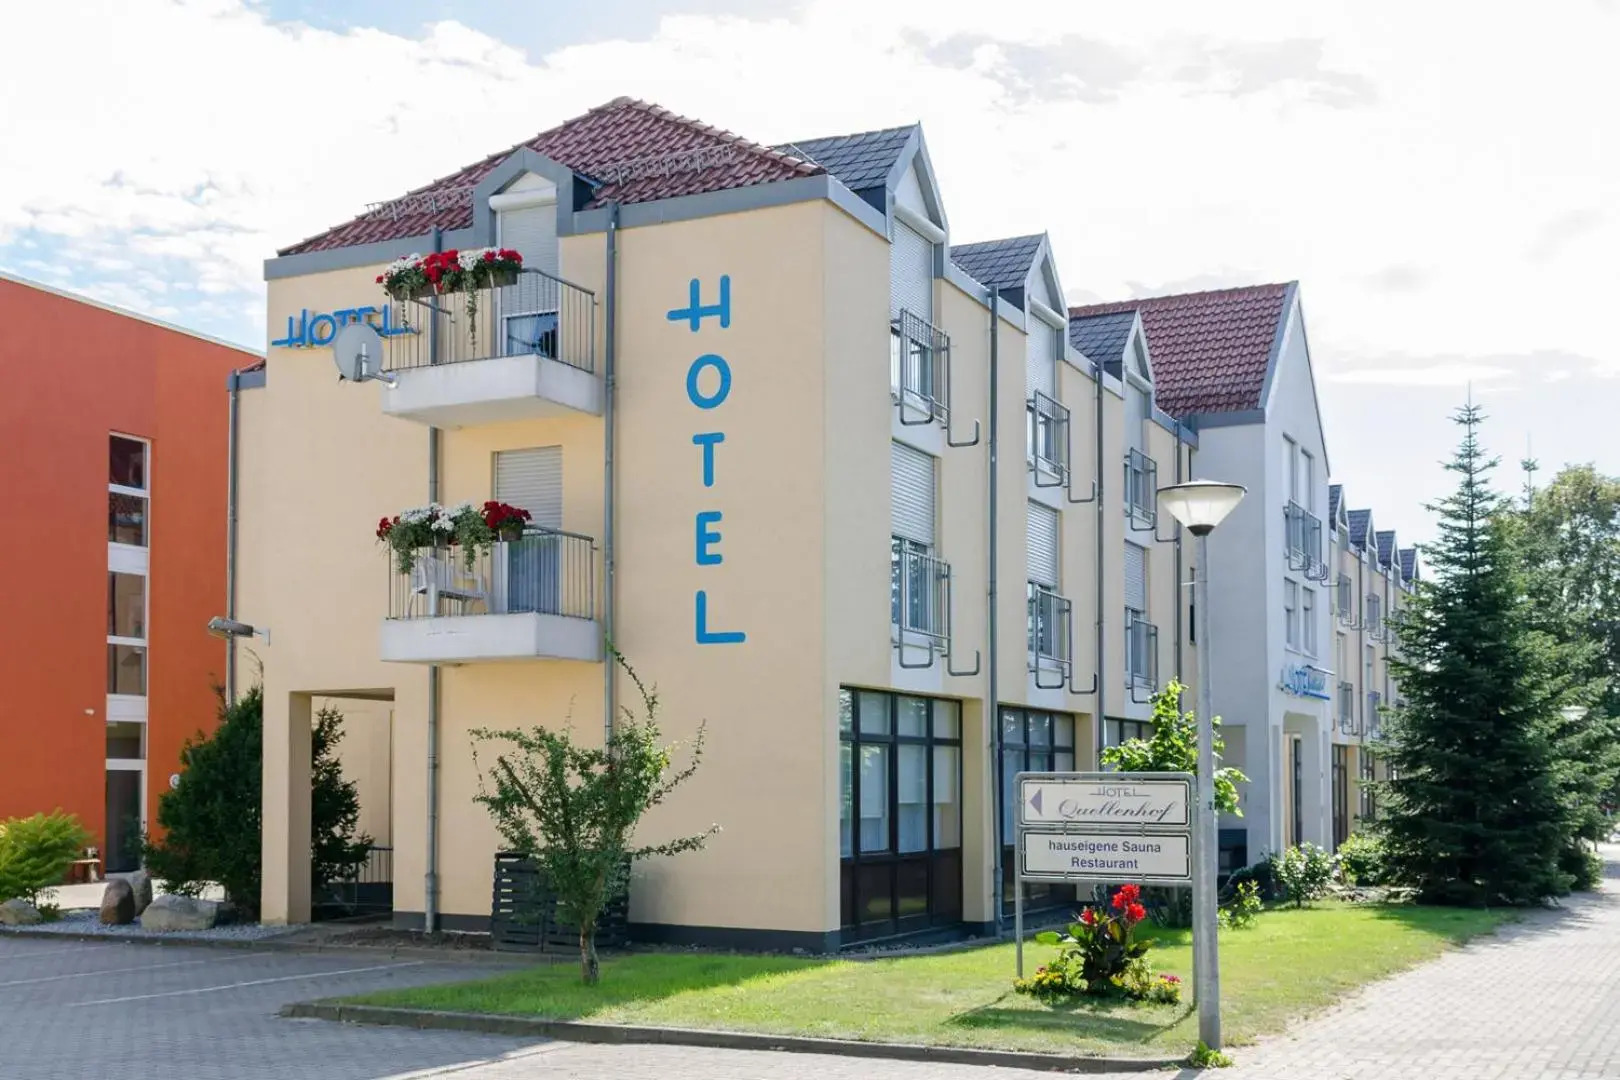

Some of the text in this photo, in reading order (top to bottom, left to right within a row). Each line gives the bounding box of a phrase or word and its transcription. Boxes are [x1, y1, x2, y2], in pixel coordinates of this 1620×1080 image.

[666, 275, 746, 644] HOTEL
[1089, 786, 1151, 798] HOTEL
[1058, 799, 1177, 822] Quellenhof
[1049, 840, 1161, 854] hauseigene Sauna
[1071, 856, 1139, 869] Restaurant
